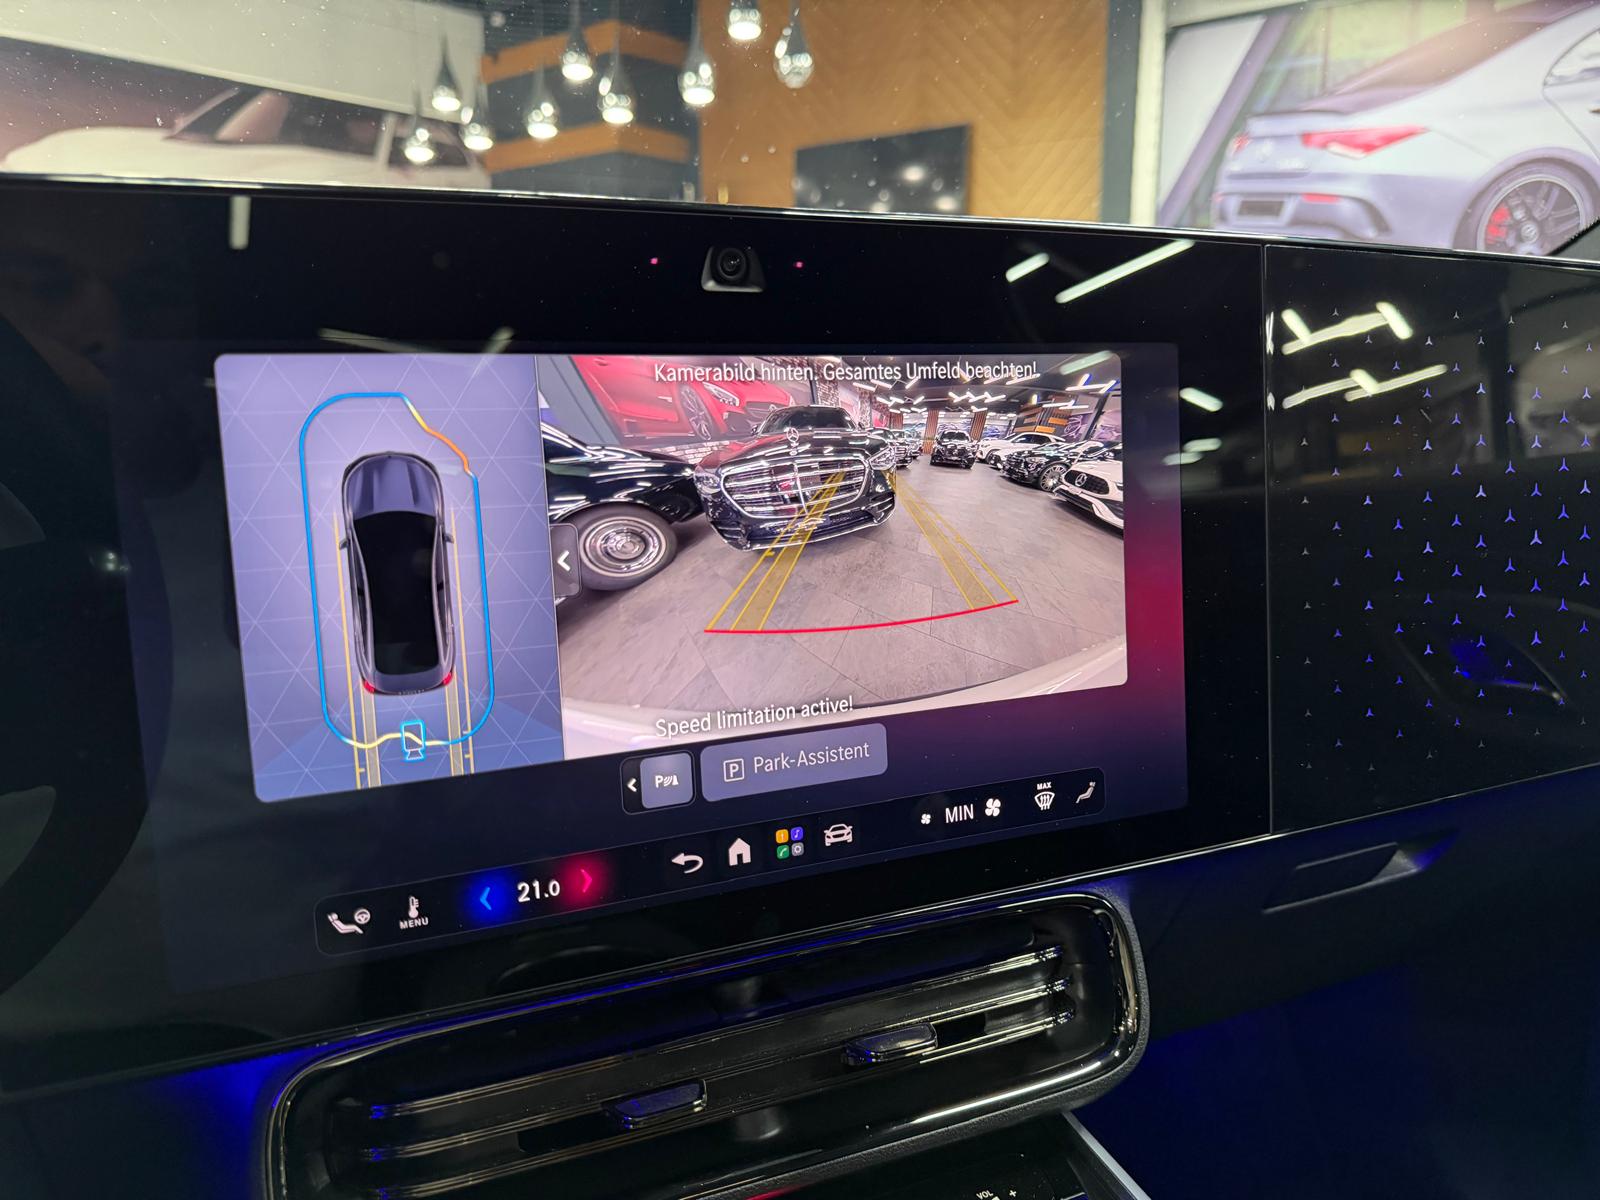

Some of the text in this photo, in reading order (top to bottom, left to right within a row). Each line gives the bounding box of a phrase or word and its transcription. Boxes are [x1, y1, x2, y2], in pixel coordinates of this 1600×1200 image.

[654, 361, 1037, 382] Kamerabild hinten. Gesamtes Umfeld beachten!
[655, 695, 854, 738] Speed limitation active!
[753, 742, 870, 773] Park-Assistent
[1036, 782, 1052, 790] MAX
[945, 804, 974, 823] MIN
[517, 879, 561, 902] 21.0
[399, 917, 429, 929] MENU
[976, 1190, 994, 1200] VOL
